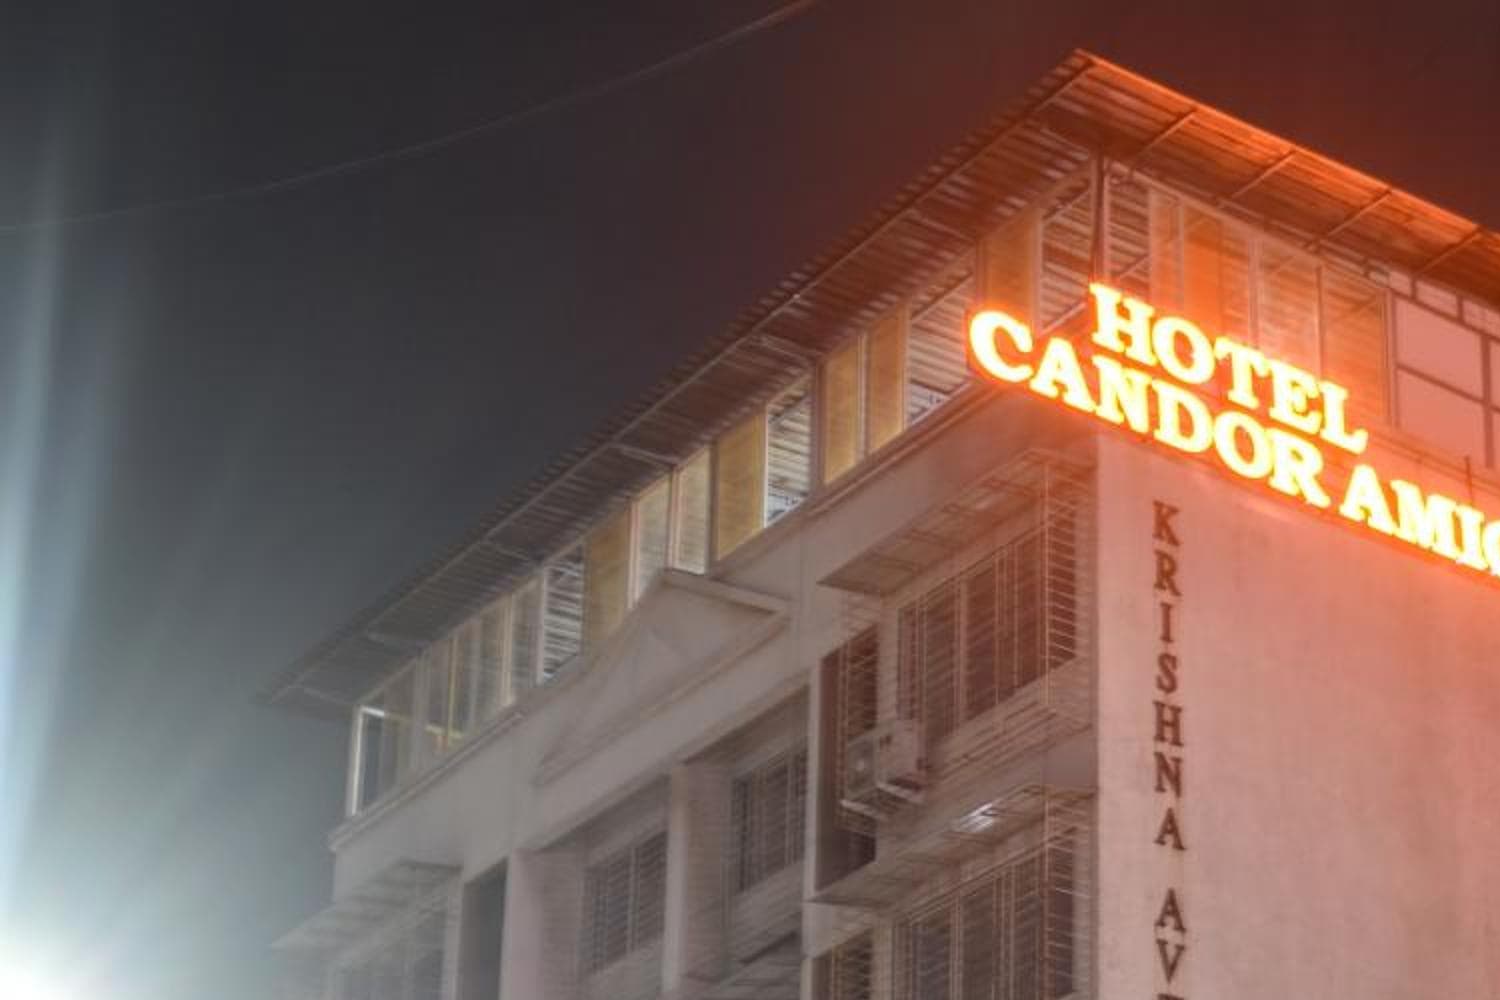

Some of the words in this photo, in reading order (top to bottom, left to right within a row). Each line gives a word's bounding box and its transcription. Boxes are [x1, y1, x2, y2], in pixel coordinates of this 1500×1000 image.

[968, 309, 1331, 508] CANDOR
[1088, 281, 1368, 455] HOTEL
[1152, 499, 1186, 851] KRISHNA
